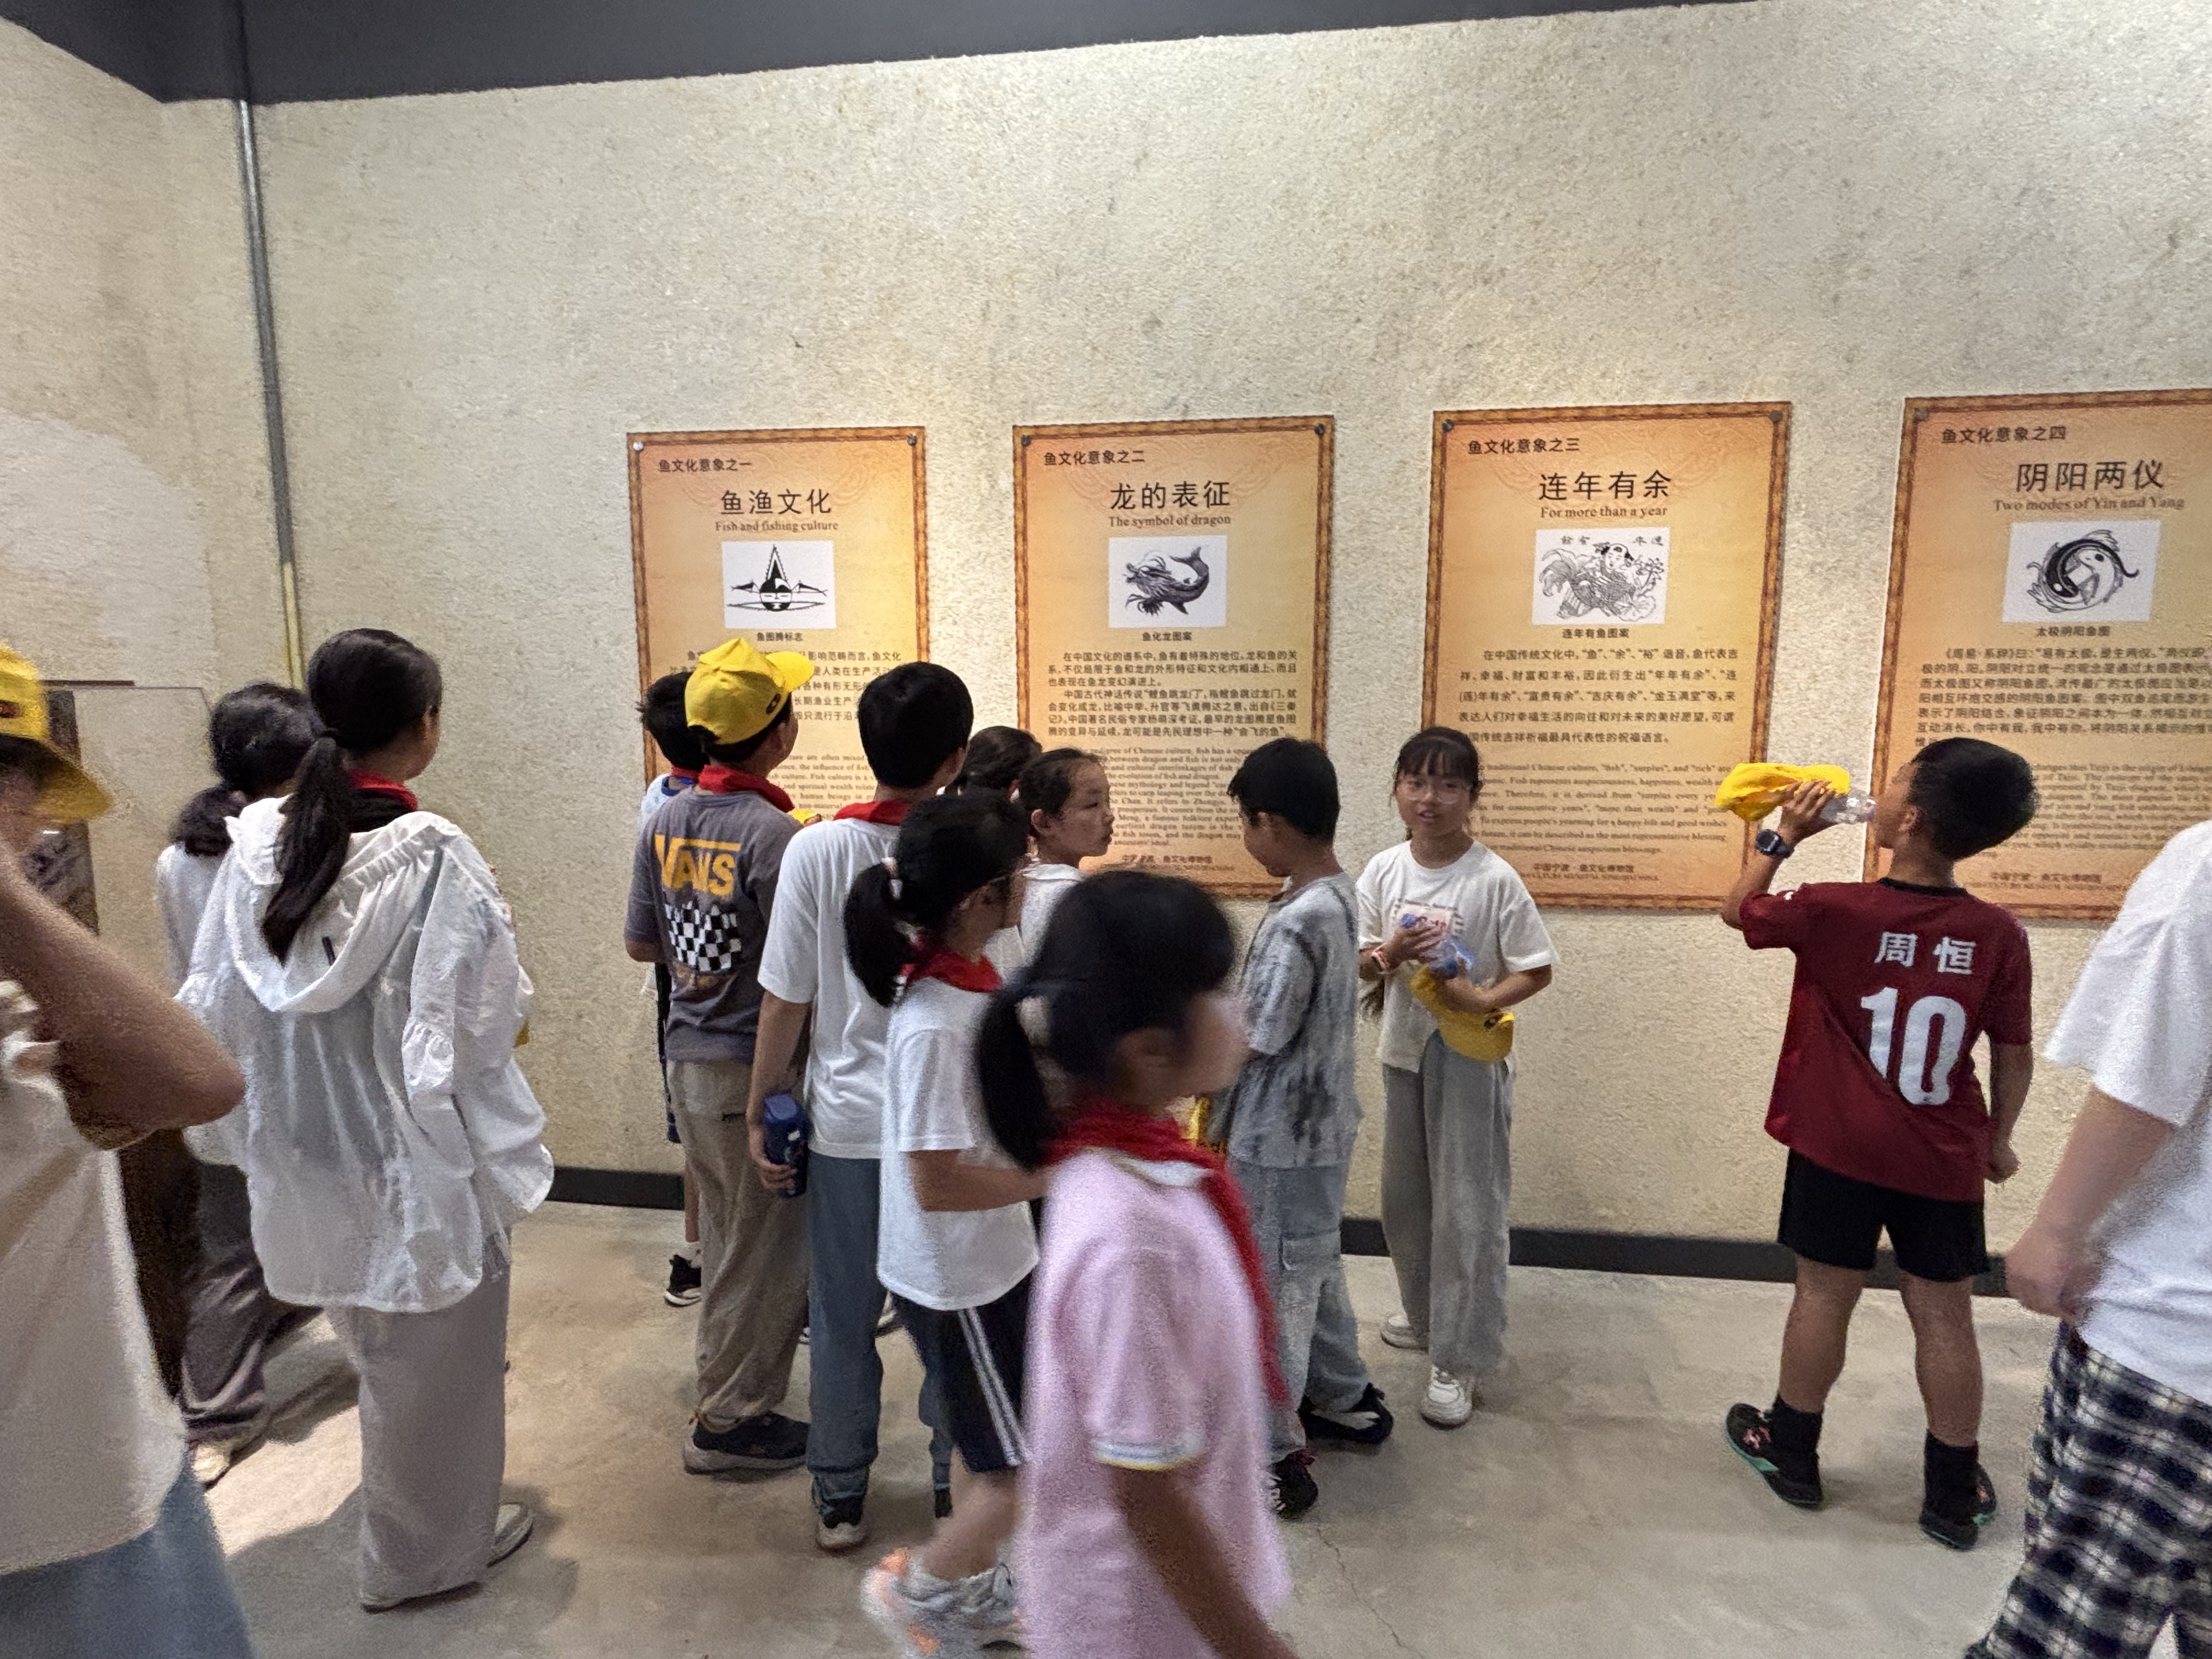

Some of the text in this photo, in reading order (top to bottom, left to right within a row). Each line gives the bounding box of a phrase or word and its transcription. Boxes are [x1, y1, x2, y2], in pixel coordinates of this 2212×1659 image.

[1942, 426, 2066, 443] 鱼文化意象之四
[1468, 438, 1579, 455] 鱼文化意象之三
[658, 459, 752, 472] 鱼文化意象之一
[1044, 450, 1145, 466] 鱼文化意象之二
[2016, 460, 2164, 492] 阴阳两仪
[1538, 470, 1672, 501] 连年有余
[720, 489, 832, 515] 鱼渔文化
[1110, 481, 1231, 509] 龙的表征
[1994, 497, 2185, 511] Two modes of Yin and Yang
[1541, 507, 1561, 518] For
[1564, 509, 1597, 517] more
[1600, 506, 1627, 517] than
[1639, 508, 1668, 519] year
[715, 520, 838, 533] Fish and fishing culture
[1109, 514, 1231, 528] The symbol of dragon
[757, 632, 803, 642] 鱼图腾标志
[1142, 632, 1192, 641] 鱼化龙图案
[1562, 628, 1629, 640] 连年有鱼图案
[1875, 932, 1977, 975] 周恒
[1860, 986, 1967, 1105] 10
